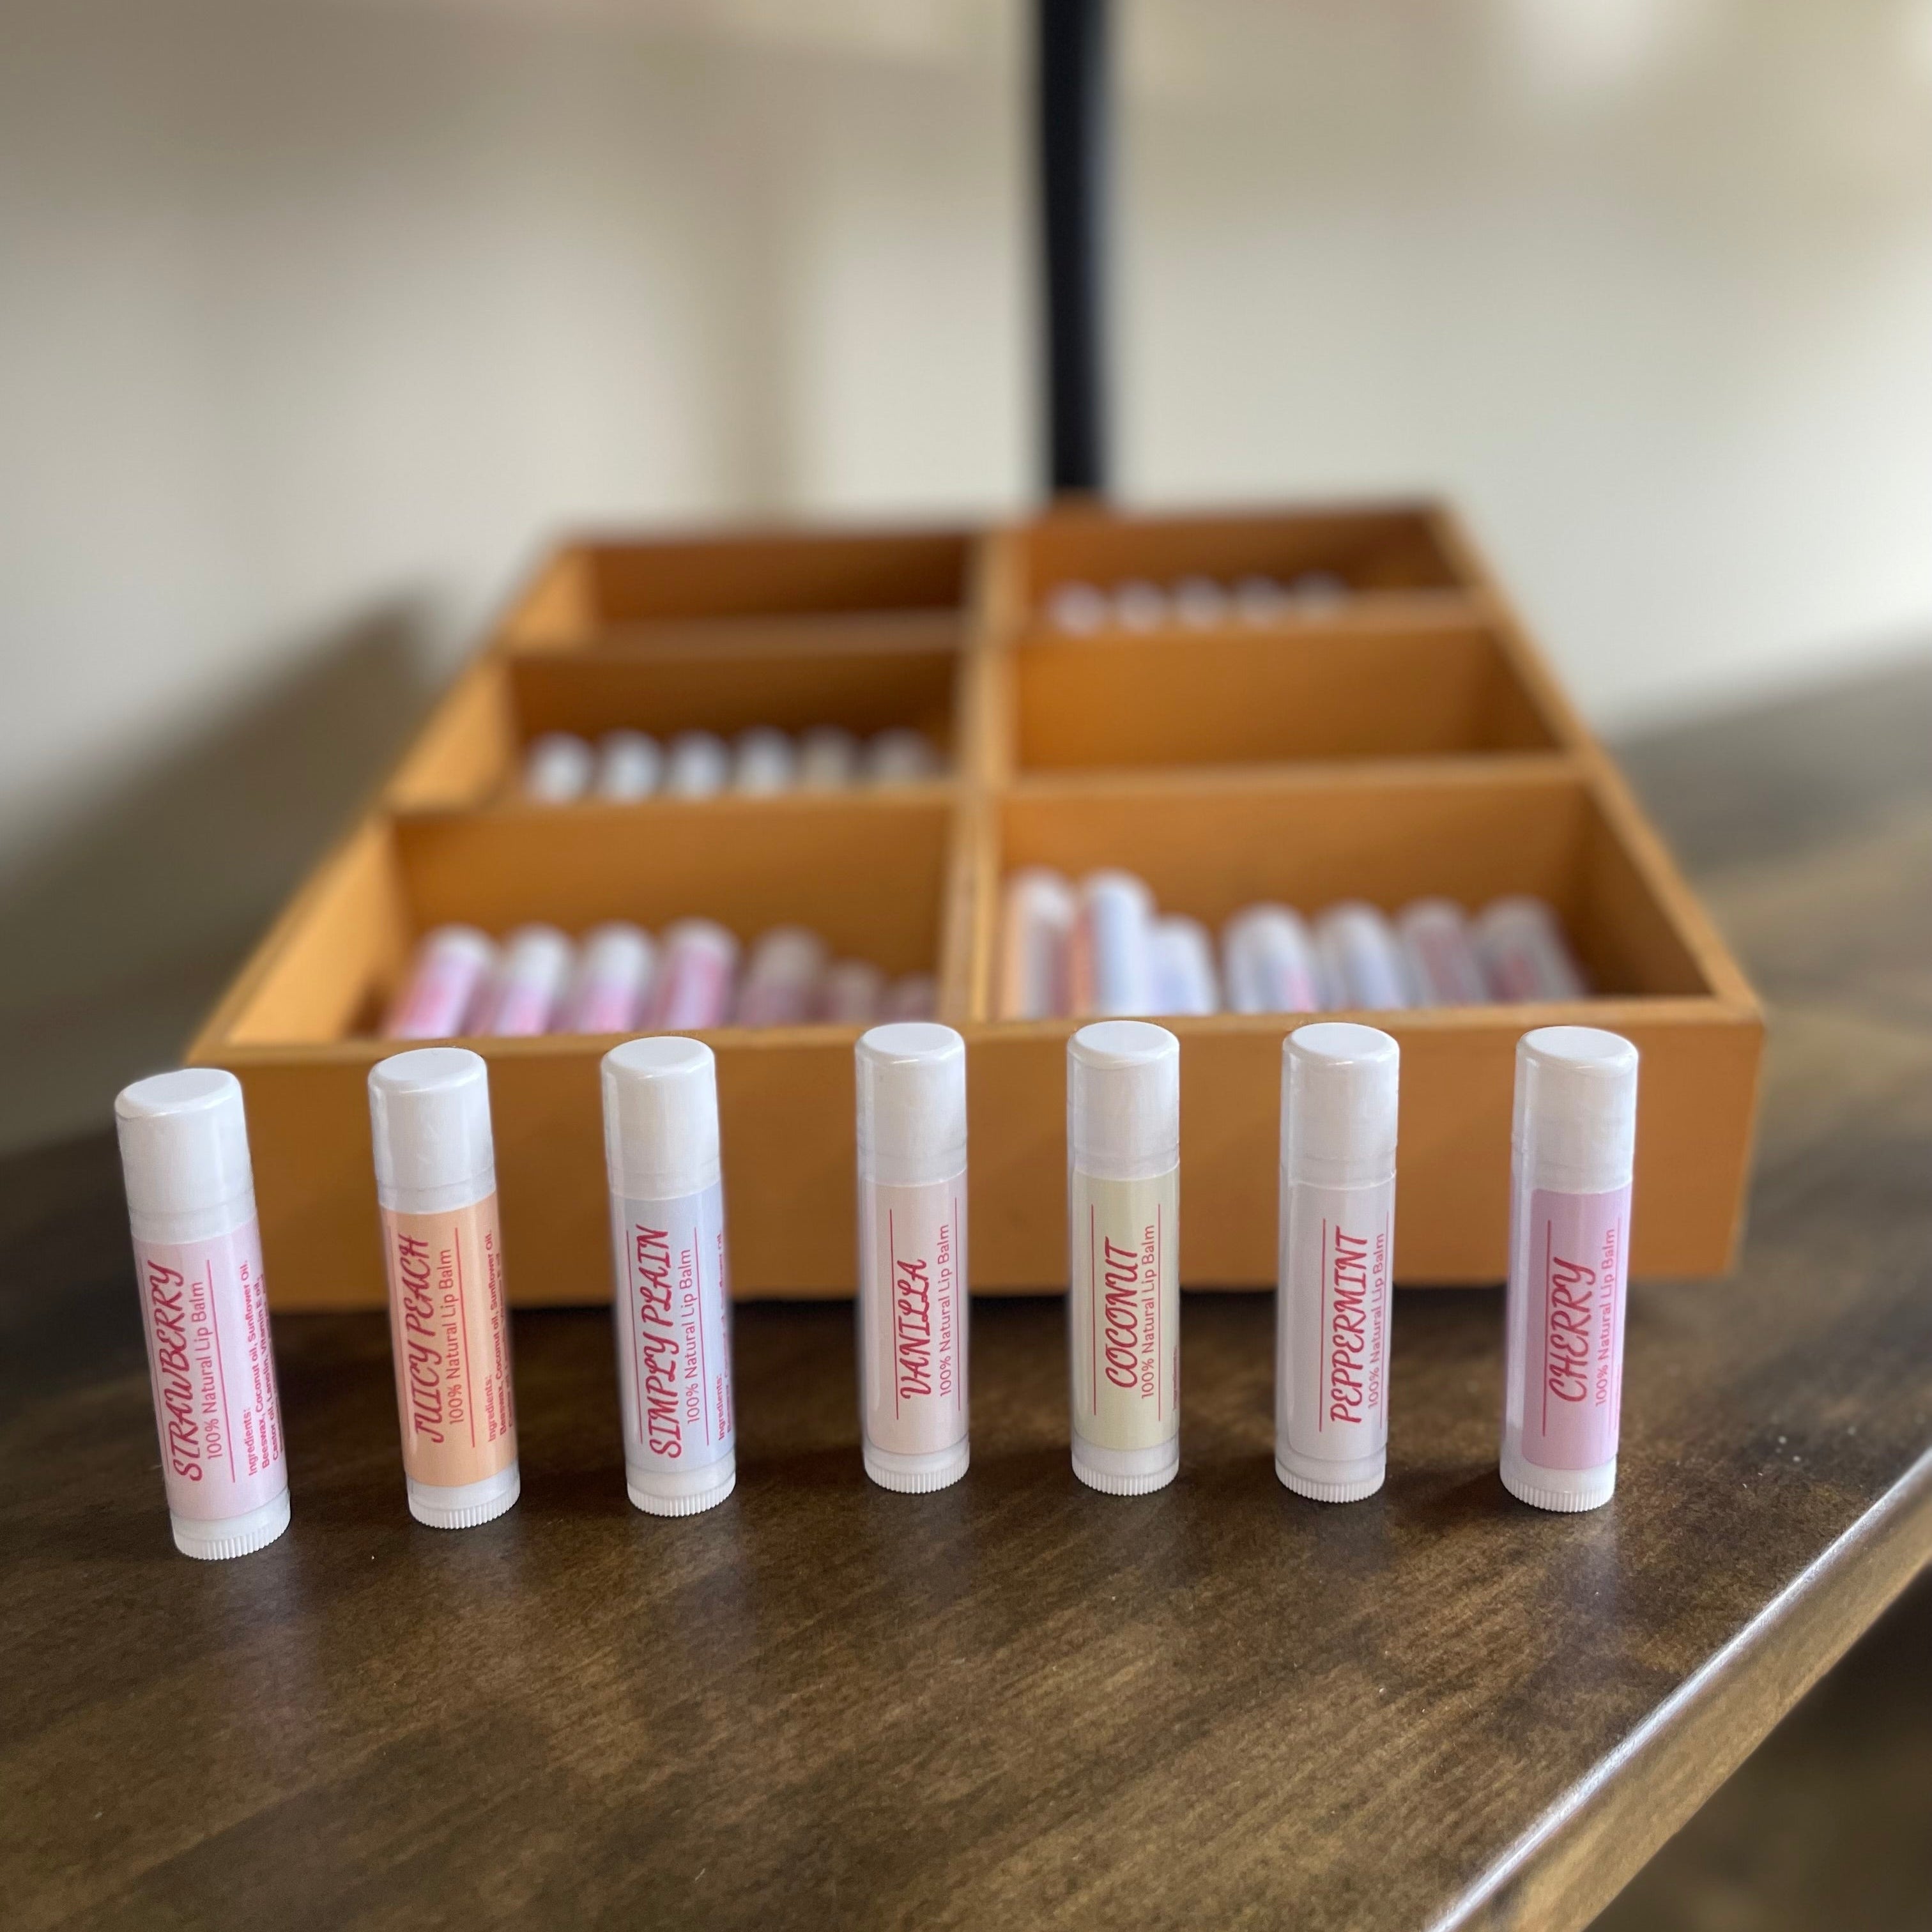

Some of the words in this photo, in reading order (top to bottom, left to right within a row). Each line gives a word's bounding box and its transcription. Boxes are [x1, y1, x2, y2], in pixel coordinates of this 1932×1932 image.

[936, 1224, 950, 1264] Balm
[1141, 1225, 1155, 1264] Balm
[1373, 1234, 1384, 1273] Balm
[1602, 1229, 1614, 1268] Balm
[399, 1234, 436, 1337] PEACH
[437, 1250, 454, 1289] Balm
[636, 1223, 673, 1327] PLAIN
[678, 1249, 693, 1289] Balm
[937, 1268, 953, 1291] Lip
[1141, 1269, 1156, 1292] Lip
[1372, 1277, 1385, 1301] Lip
[1599, 1275, 1614, 1298] Lip
[190, 1282, 206, 1321] Balm
[440, 1294, 459, 1317] Lip
[680, 1294, 696, 1317] Lip
[1104, 1236, 1138, 1388] COCONUT
[194, 1328, 213, 1351] Lip
[897, 1259, 931, 1399] VANILLA
[937, 1296, 951, 1351] Natural
[1141, 1298, 1155, 1353] Natural
[1330, 1225, 1367, 1423] PEPPERMINT
[1370, 1307, 1383, 1363] Natural
[1549, 1257, 1595, 1402] CHERRY
[1598, 1303, 1612, 1360] Natural
[442, 1322, 461, 1379] Natural
[681, 1321, 697, 1378] Natural
[148, 1261, 203, 1482] STRAWBERRY
[197, 1358, 217, 1413] Natural
[407, 1340, 445, 1443] JUICY
[939, 1356, 952, 1397] 100%
[1141, 1358, 1154, 1399] 100%
[1367, 1367, 1380, 1408] 100%
[1595, 1365, 1608, 1406] 100%
[447, 1384, 464, 1425] 100%
[641, 1331, 682, 1458] SIMPLY
[686, 1383, 700, 1424] 100%
[205, 1419, 223, 1459] 100%
